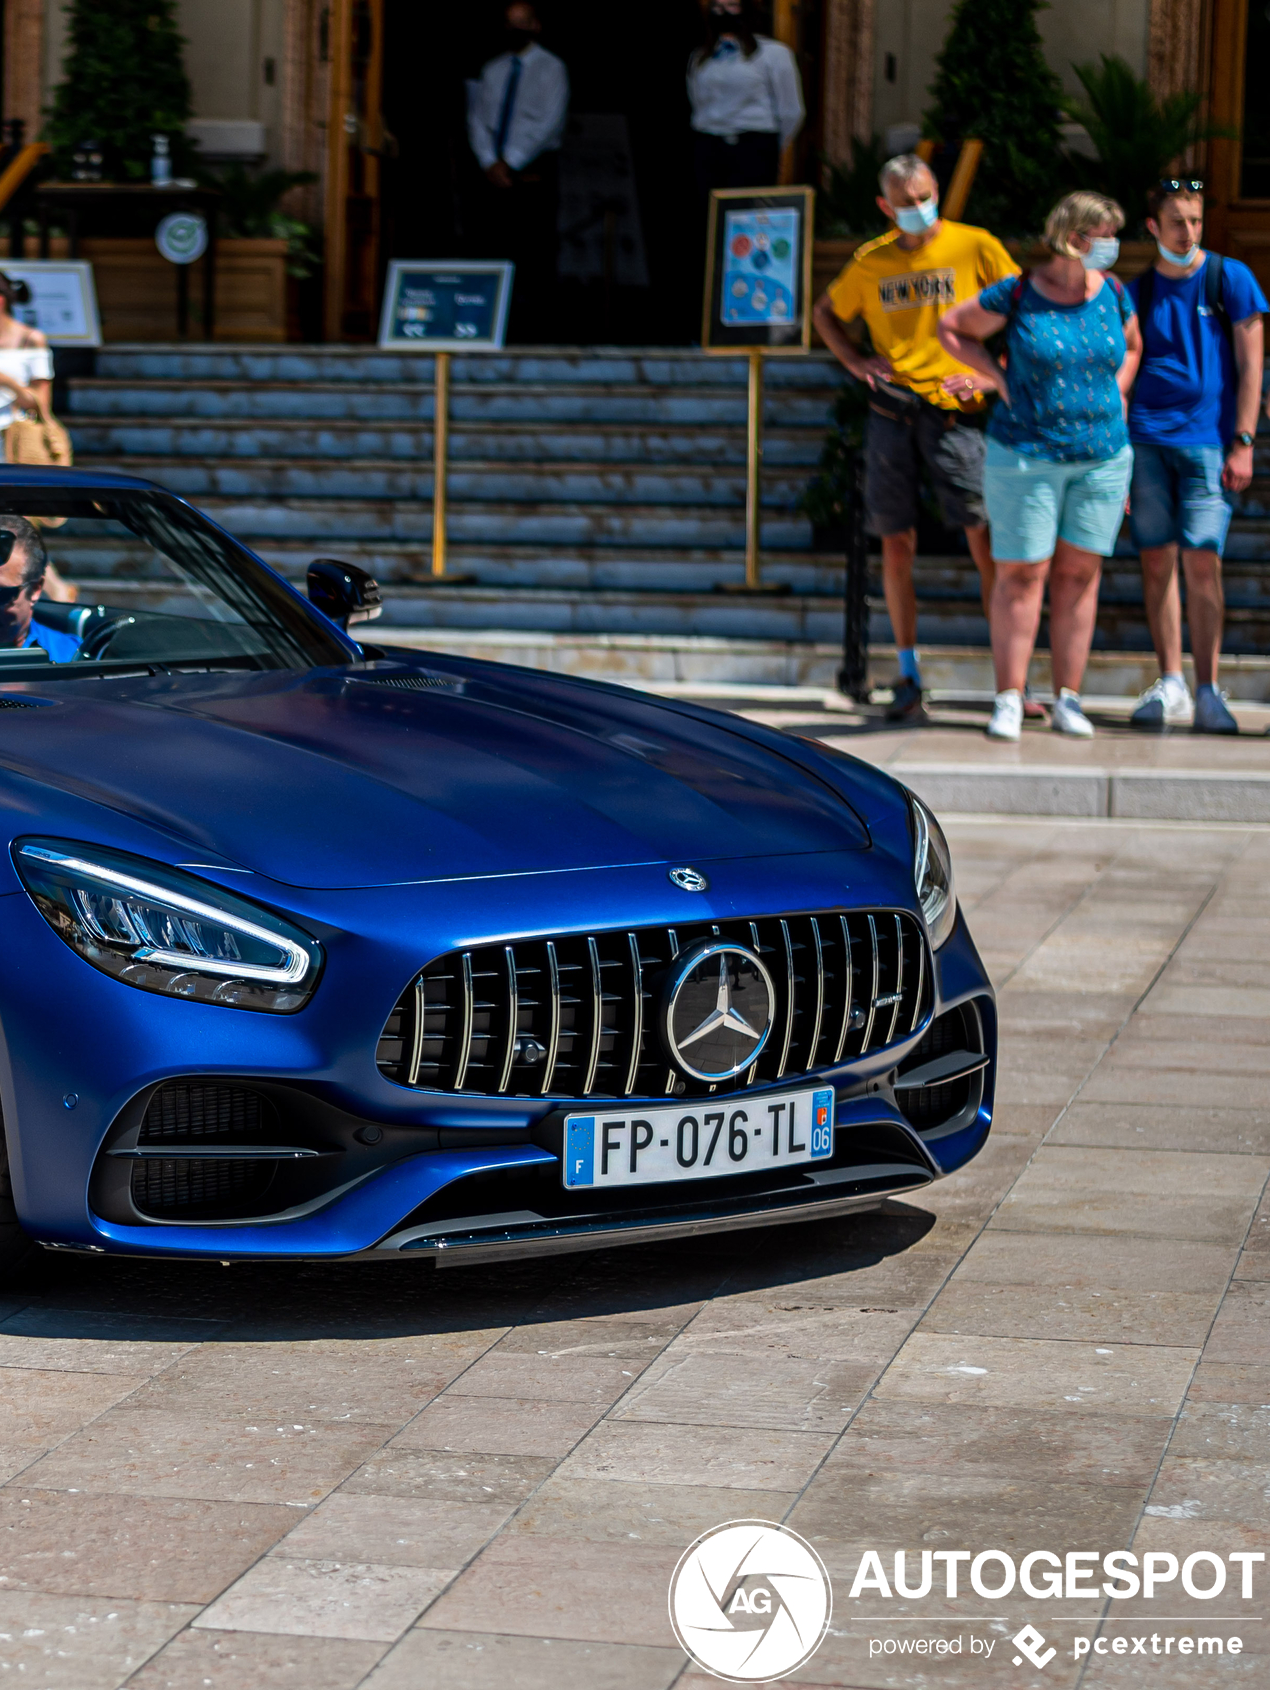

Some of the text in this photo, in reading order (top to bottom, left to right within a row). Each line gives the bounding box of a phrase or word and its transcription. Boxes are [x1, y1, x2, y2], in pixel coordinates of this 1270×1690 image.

[601, 1101, 806, 1175] FP-076-TL
[812, 1126, 830, 1151] 06
[575, 1159, 584, 1174] F
